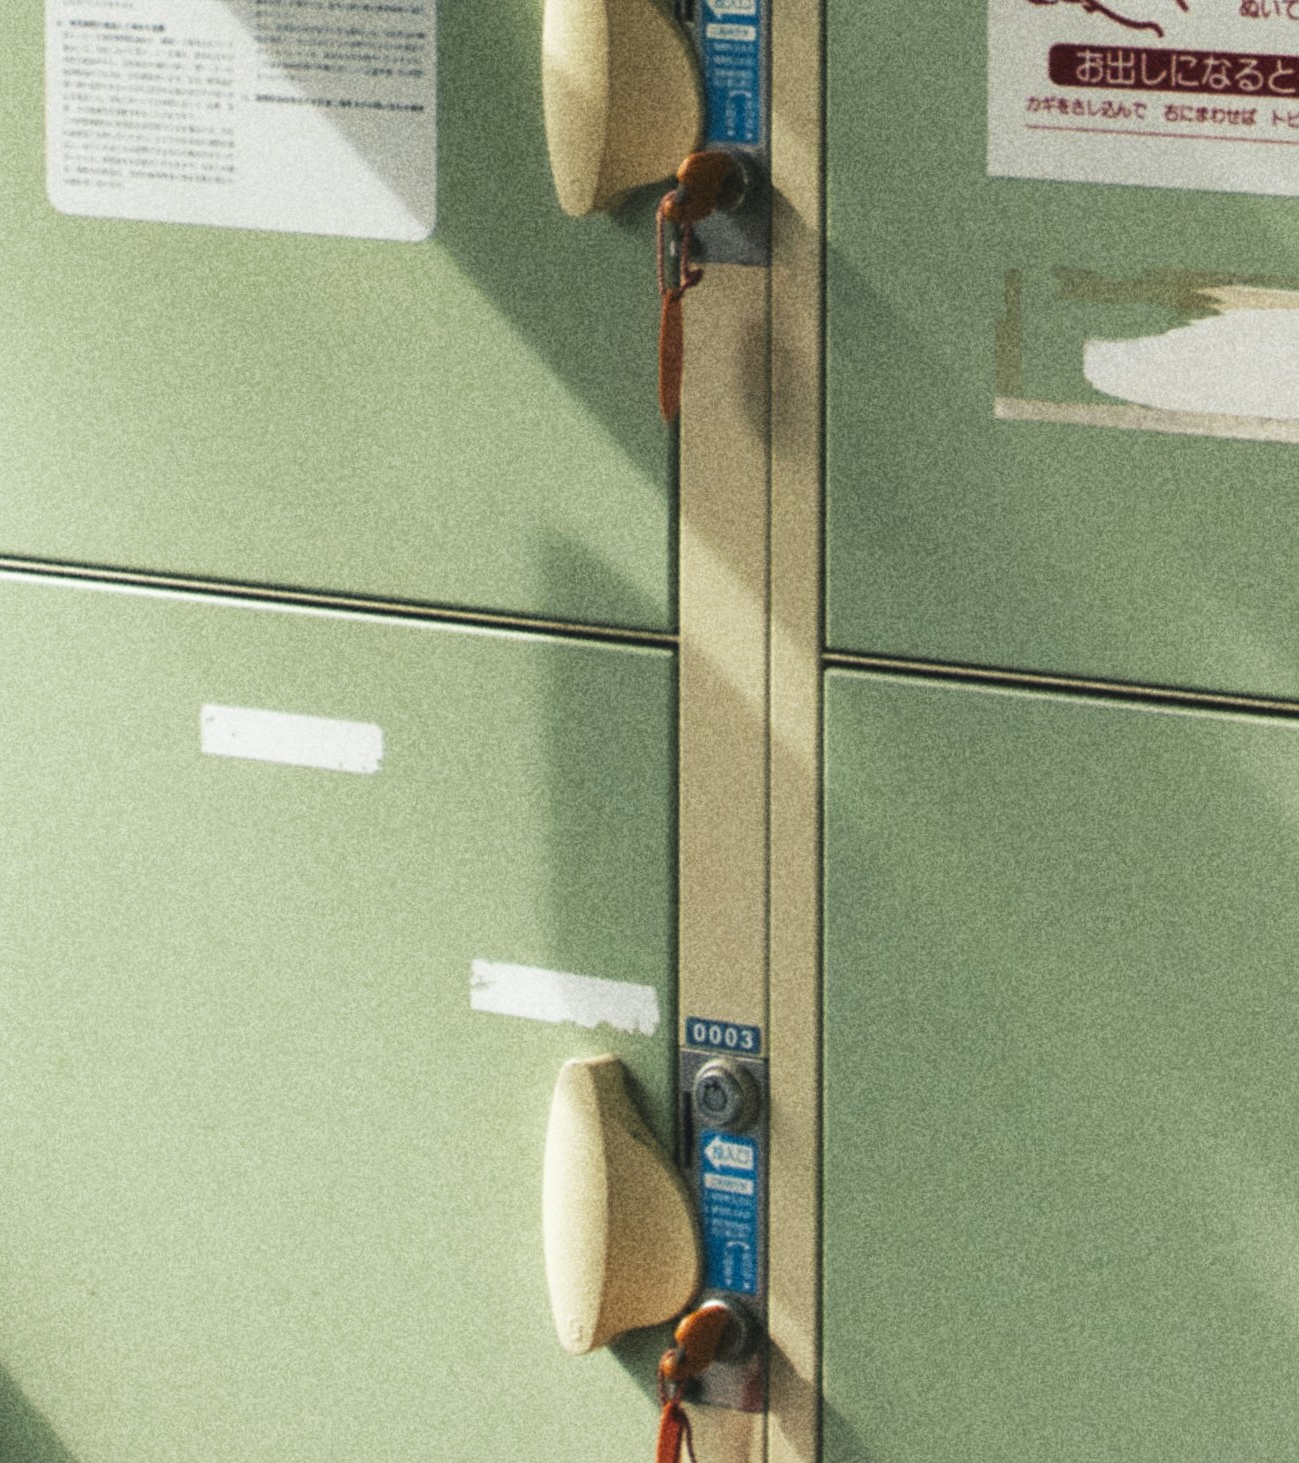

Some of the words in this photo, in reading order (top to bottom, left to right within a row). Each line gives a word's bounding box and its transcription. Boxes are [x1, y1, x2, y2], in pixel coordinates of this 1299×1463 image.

[1024, 96, 1148, 122] カギをさし込んで
[1163, 103, 1258, 127] 右にまわせば
[692, 1022, 754, 1050] 0003
